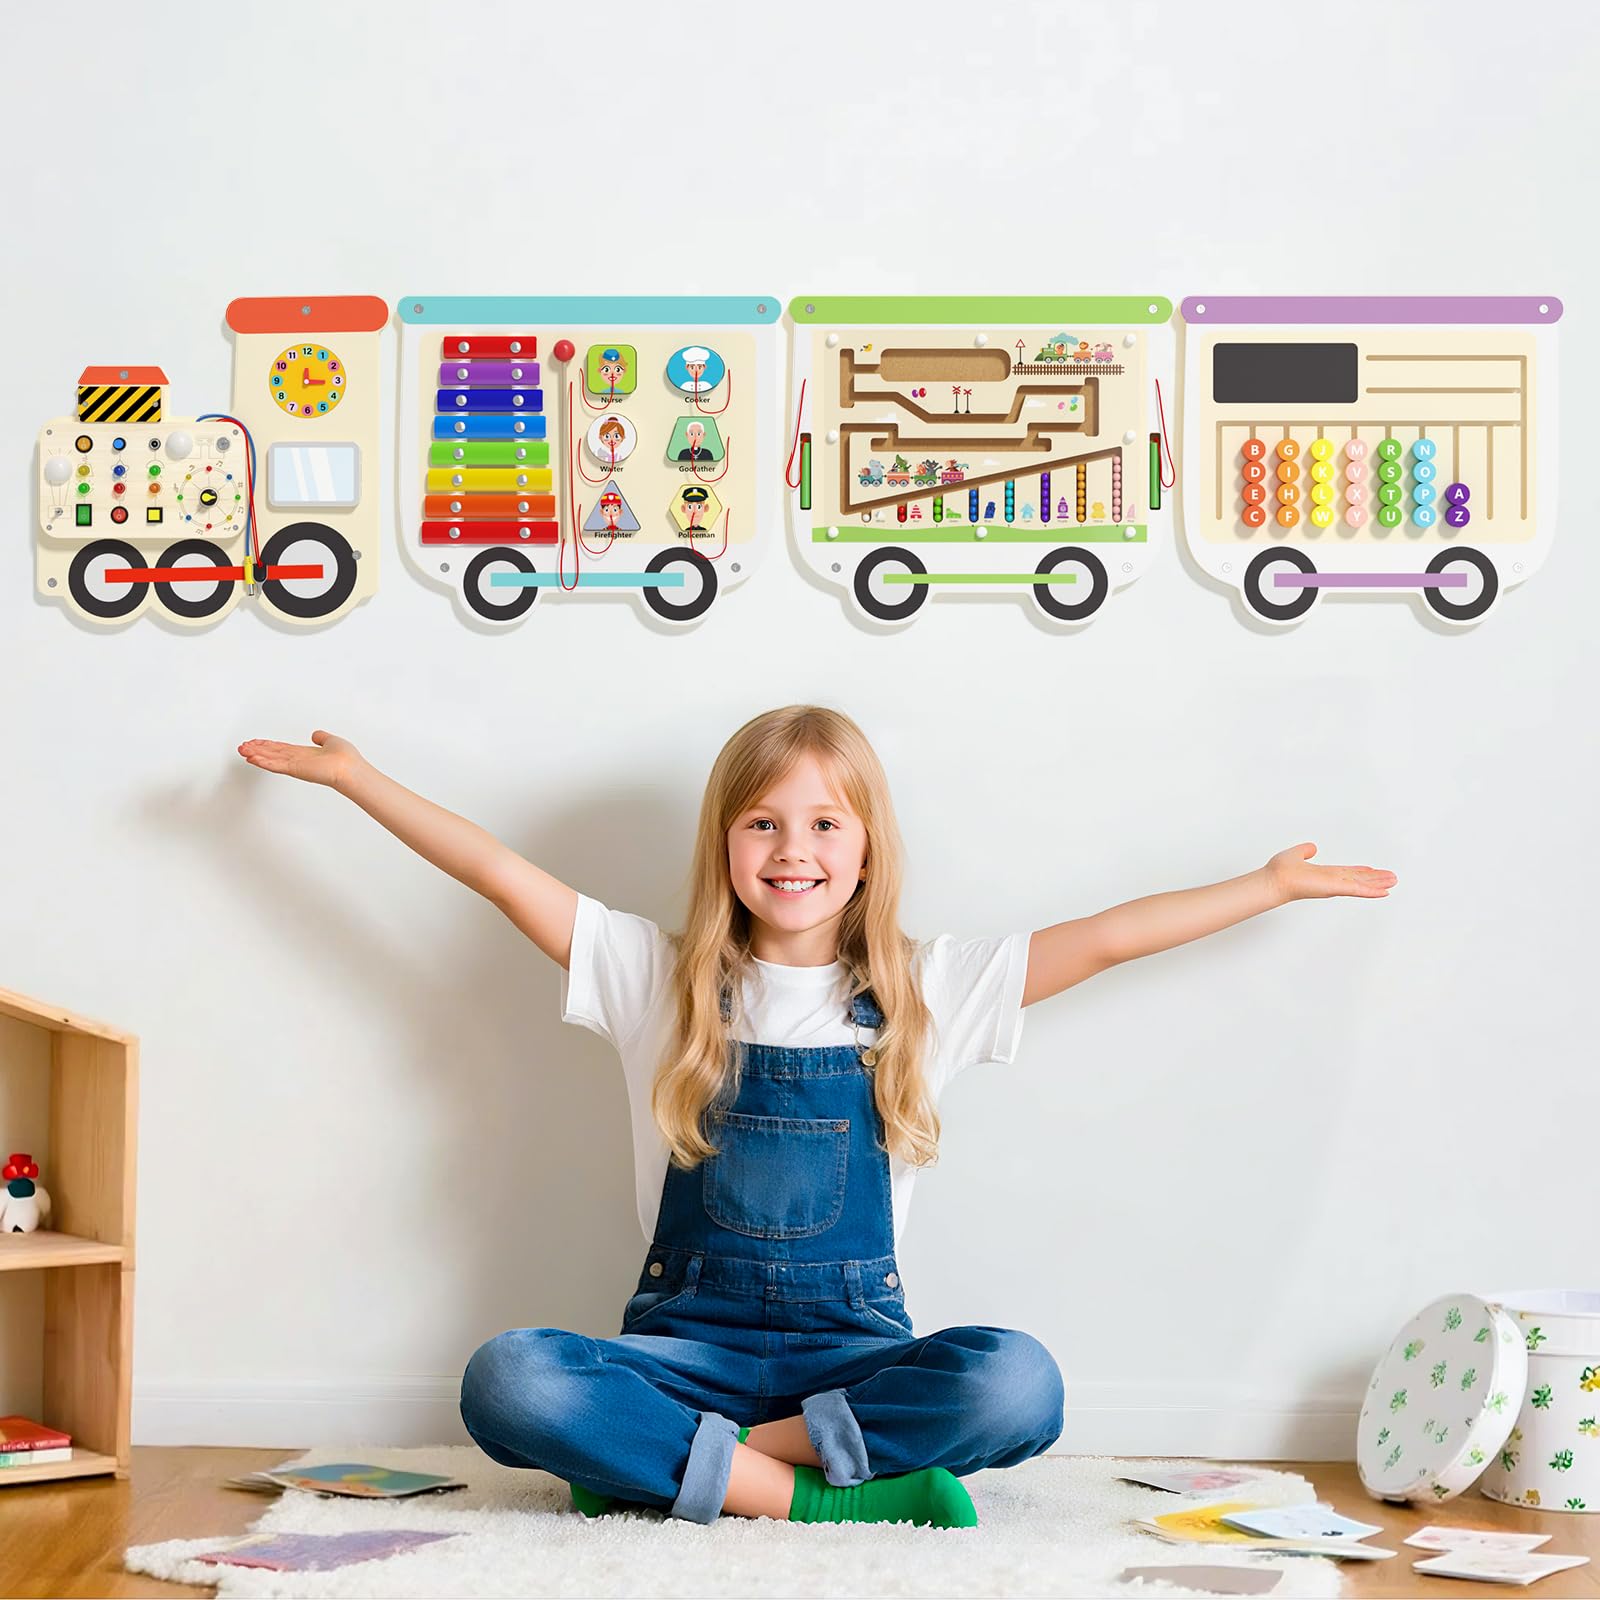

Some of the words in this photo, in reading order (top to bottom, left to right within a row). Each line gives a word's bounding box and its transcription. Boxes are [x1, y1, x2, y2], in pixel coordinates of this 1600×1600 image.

[1251, 445, 1259, 456] B
[1284, 445, 1293, 456] G
[1320, 445, 1326, 456] J
[1351, 445, 1363, 455] M
[1387, 445, 1395, 456] R
[1420, 445, 1430, 456] N
[1251, 467, 1260, 477] D
[1287, 467, 1291, 477] I
[1319, 467, 1327, 478] K
[1352, 467, 1361, 477] V
[1387, 467, 1395, 478] S
[1420, 467, 1430, 478] O
[1252, 489, 1259, 500] E
[1284, 489, 1294, 500] H
[1320, 489, 1326, 499] L
[1353, 489, 1361, 499] X
[1387, 490, 1395, 500] T
[1421, 489, 1430, 499] P
[1454, 488, 1464, 499] A
[1250, 511, 1259, 522] C
[1285, 512, 1292, 522] F
[1316, 512, 1330, 522] W
[1353, 512, 1361, 522] Y
[1386, 512, 1395, 522] U
[1420, 511, 1430, 522] Q
[1455, 511, 1464, 522] Z
[594, 532, 632, 540] Firefighter
